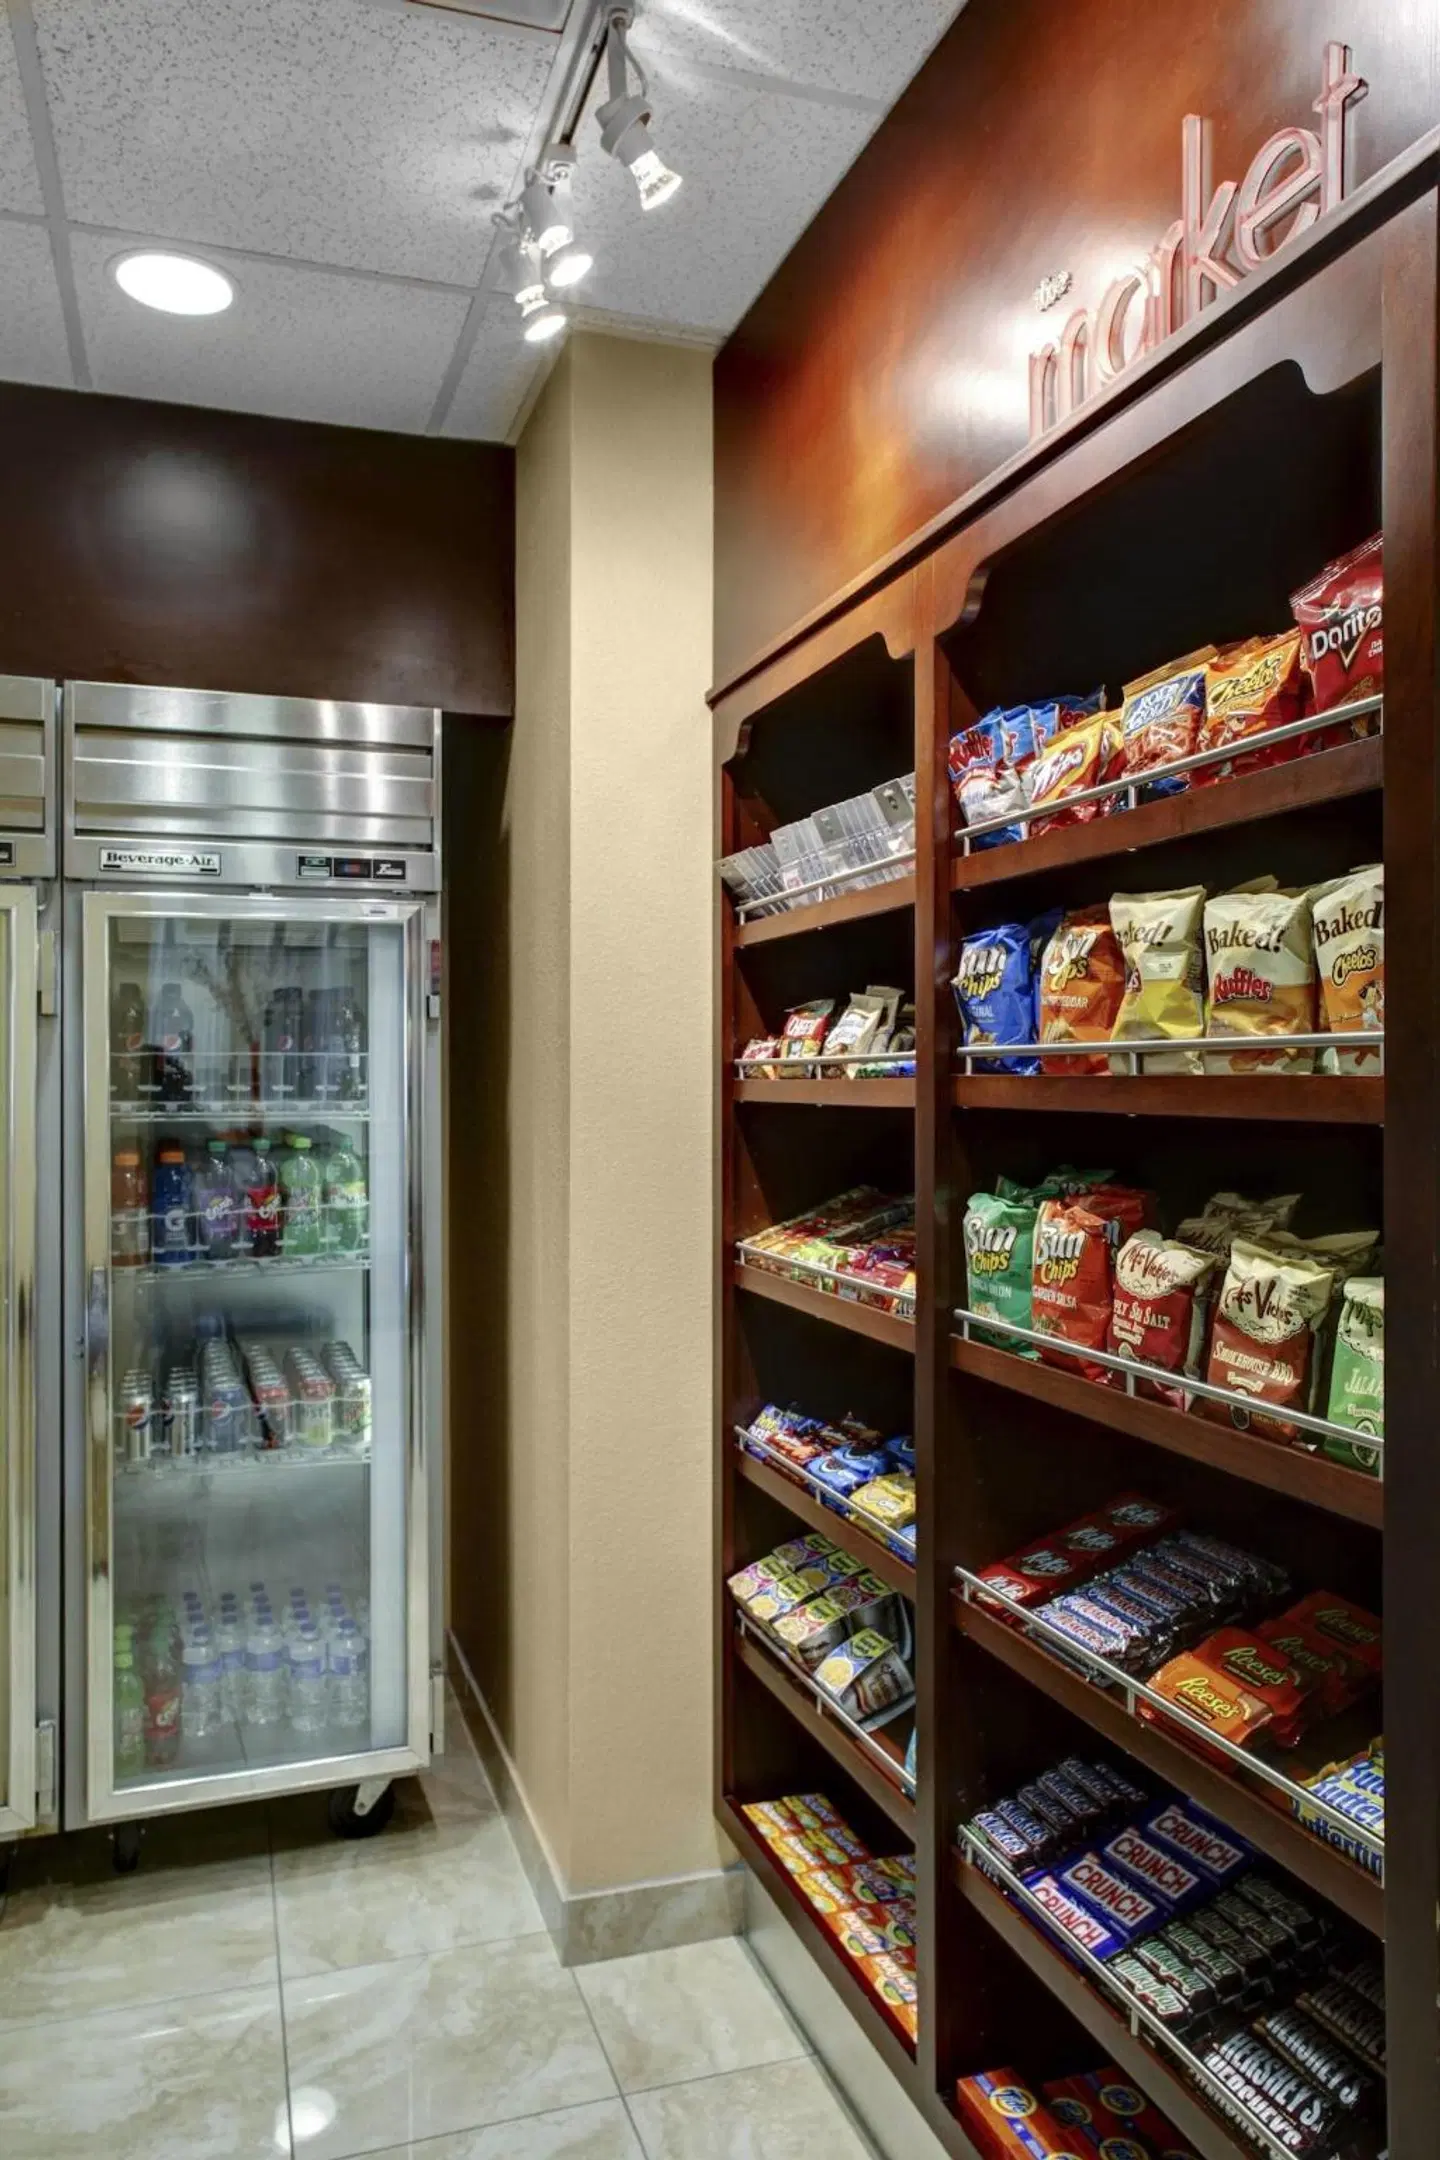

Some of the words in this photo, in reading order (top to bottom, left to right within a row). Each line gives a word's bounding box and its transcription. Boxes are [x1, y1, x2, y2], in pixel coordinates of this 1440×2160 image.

[1028, 41, 1369, 441] market
[1310, 606, 1383, 660] Dorito
[1207, 920, 1287, 954] Baked!
[1331, 944, 1378, 986] Cheetos
[1213, 967, 1273, 1004] Ruffles
[966, 1217, 1018, 1253] Sun
[1037, 1226, 1087, 1265] Sun
[971, 1252, 1011, 1278] Chips
[1040, 1259, 1078, 1287] Chips
[1143, 1306, 1171, 1330] SALT
[1269, 1360, 1294, 1387] BBQ
[1222, 1647, 1289, 1686] Reese's
[1175, 1676, 1241, 1719] Reese's
[1154, 1814, 1237, 1869] CRUNCH
[1113, 1837, 1193, 1894] CRUNCH
[1071, 1864, 1149, 1922] CRUNCH
[1031, 1887, 1102, 1945] CRUNCH
[1219, 2031, 1322, 2127] HERSHEY'S
